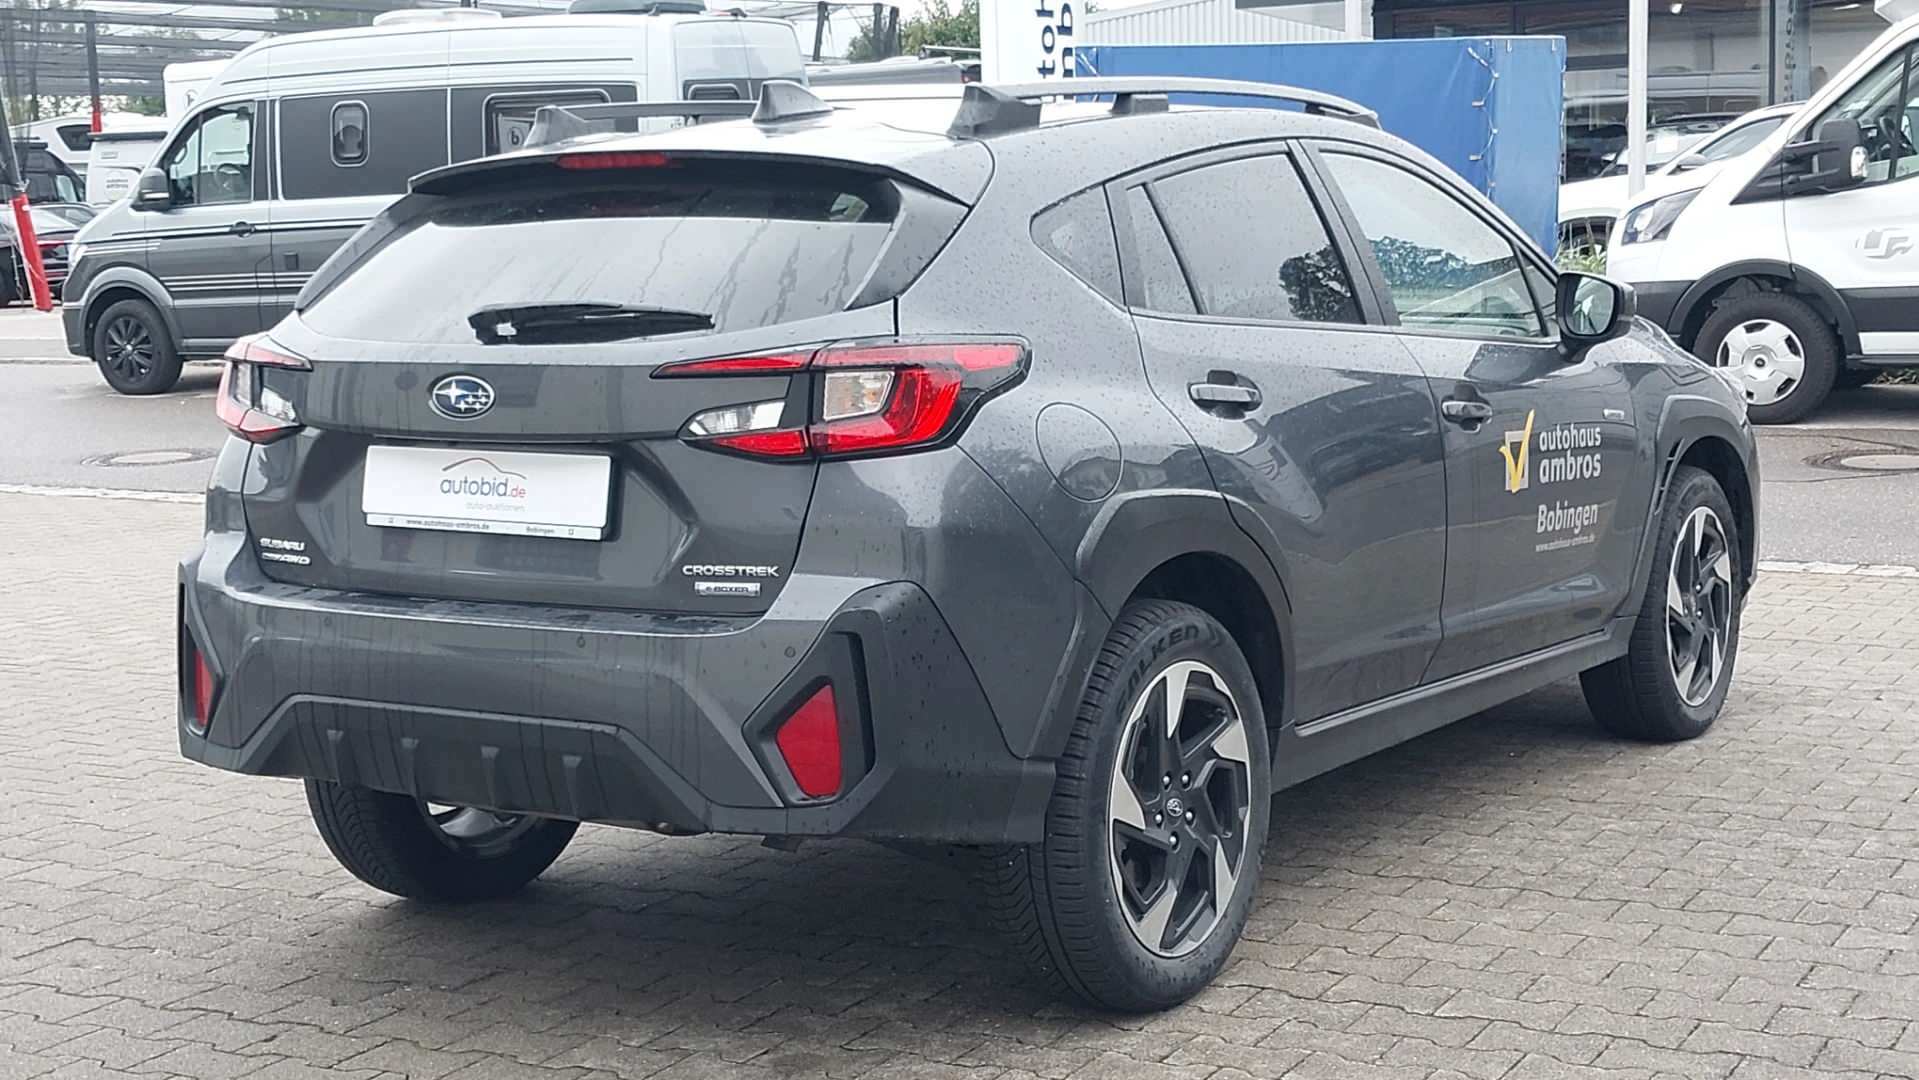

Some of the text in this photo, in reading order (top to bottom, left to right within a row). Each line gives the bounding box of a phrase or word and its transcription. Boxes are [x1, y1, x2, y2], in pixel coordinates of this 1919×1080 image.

[1539, 423, 1601, 451] autohaus
[1539, 450, 1601, 484] ambros
[440, 476, 527, 499] autobid.de
[1536, 500, 1598, 535] Bobingen
[682, 564, 780, 577] CROSSTREK
